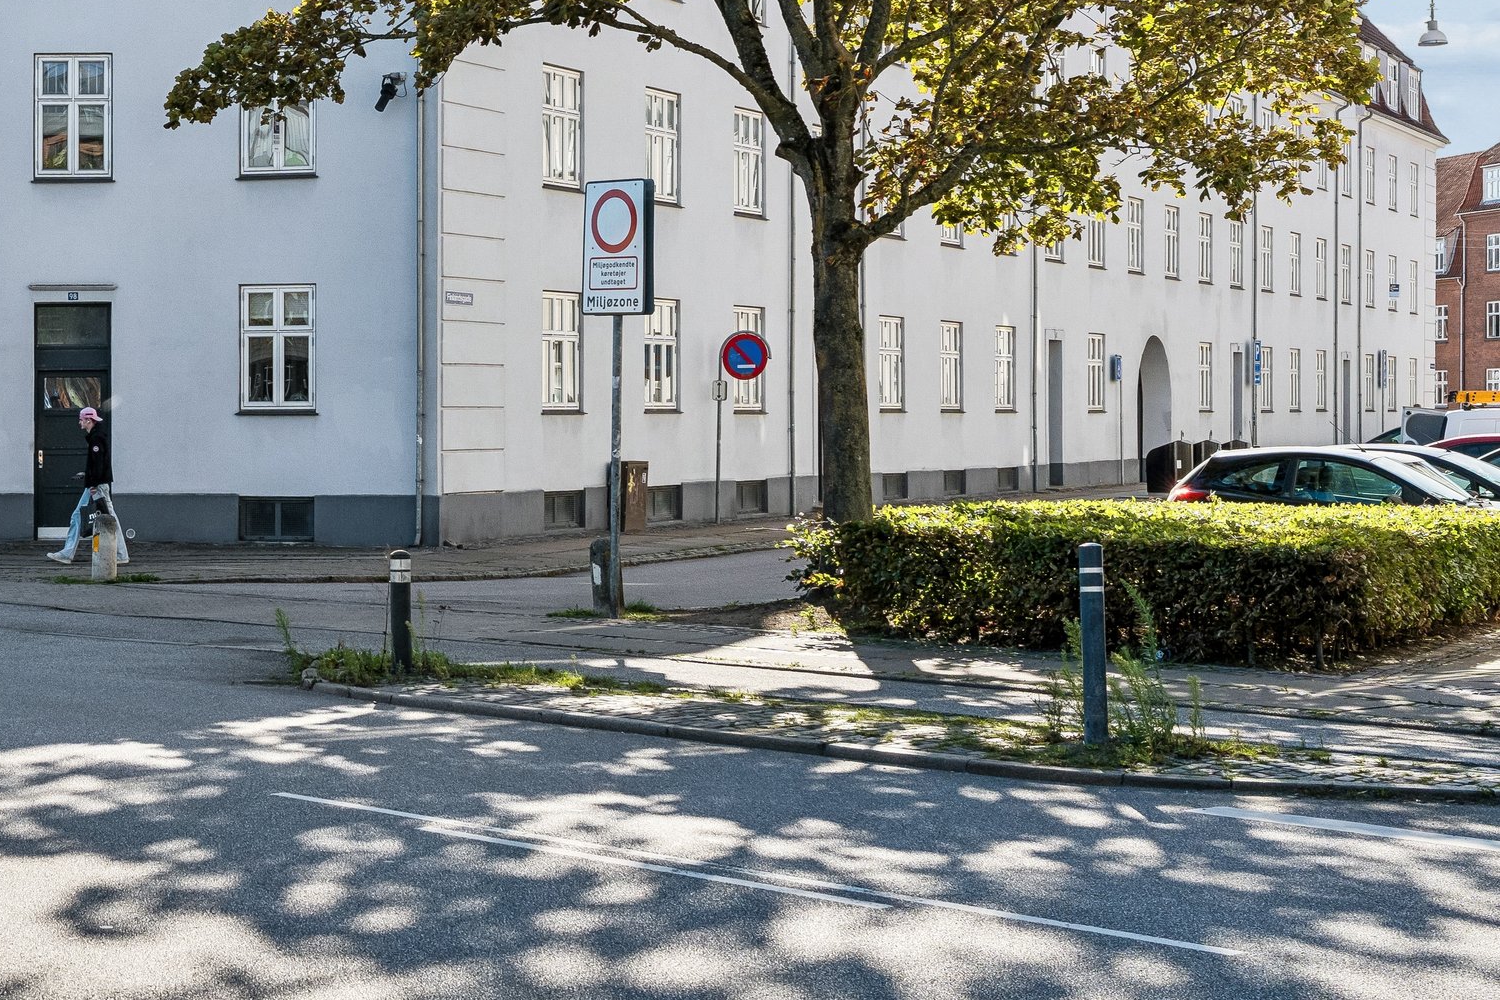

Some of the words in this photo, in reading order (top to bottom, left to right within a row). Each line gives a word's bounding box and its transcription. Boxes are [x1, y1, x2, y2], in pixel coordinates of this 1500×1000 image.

[69, 292, 77, 300] 98
[586, 296, 639, 309] Miljøzone
[1255, 344, 1260, 360] P
